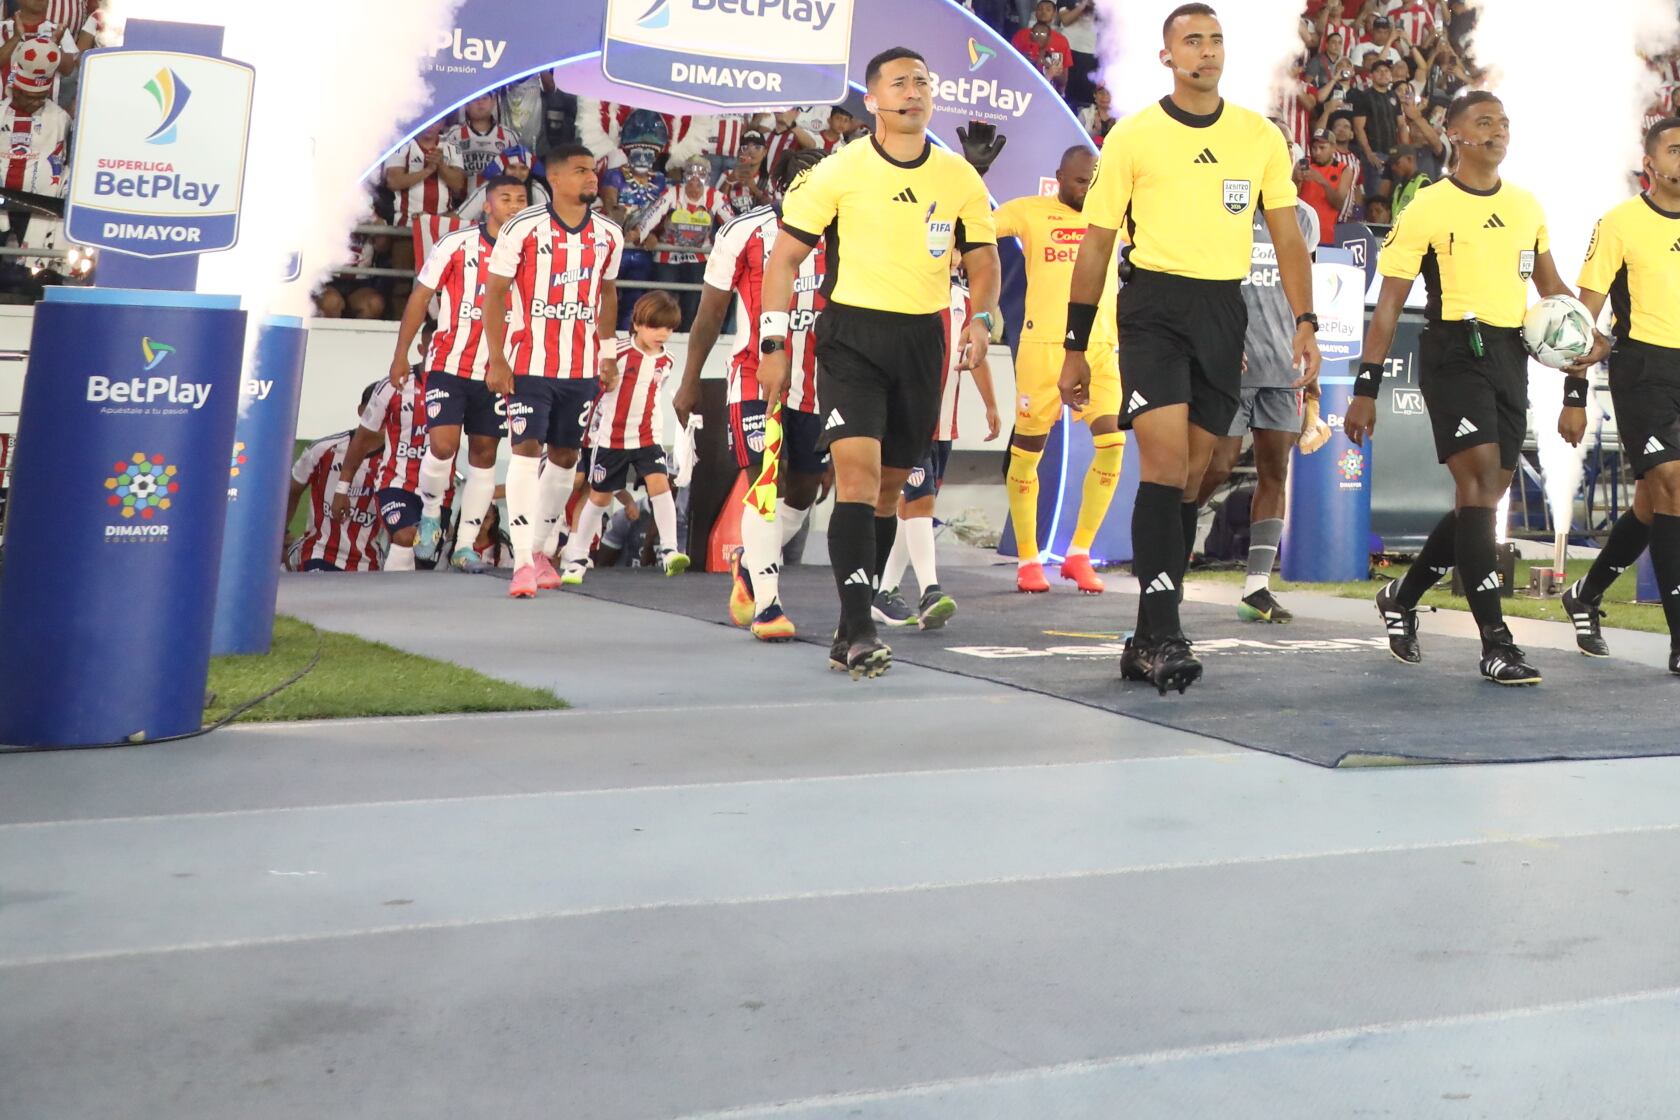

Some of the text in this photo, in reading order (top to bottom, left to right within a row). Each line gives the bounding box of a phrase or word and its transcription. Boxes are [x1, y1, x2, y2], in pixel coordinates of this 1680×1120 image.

[427, 27, 507, 69] Play
[447, 64, 477, 74] pasión
[670, 62, 783, 93] DIMAYOR
[975, 110, 983, 118] tu
[984, 111, 1008, 122] pasión
[97, 158, 174, 173] SUPERLIGA
[93, 170, 221, 208] BetPlay
[1228, 193, 1245, 202] FCF
[102, 222, 202, 243] DIMAYOR
[930, 223, 951, 233] FIFA
[553, 267, 590, 287] AGUILA
[1318, 320, 1356, 337] etPlay
[1382, 357, 1404, 378] CF
[85, 374, 213, 410] BetPlay
[104, 524, 170, 537] DIMAYOR
[1509, 543, 1515, 553] 3
